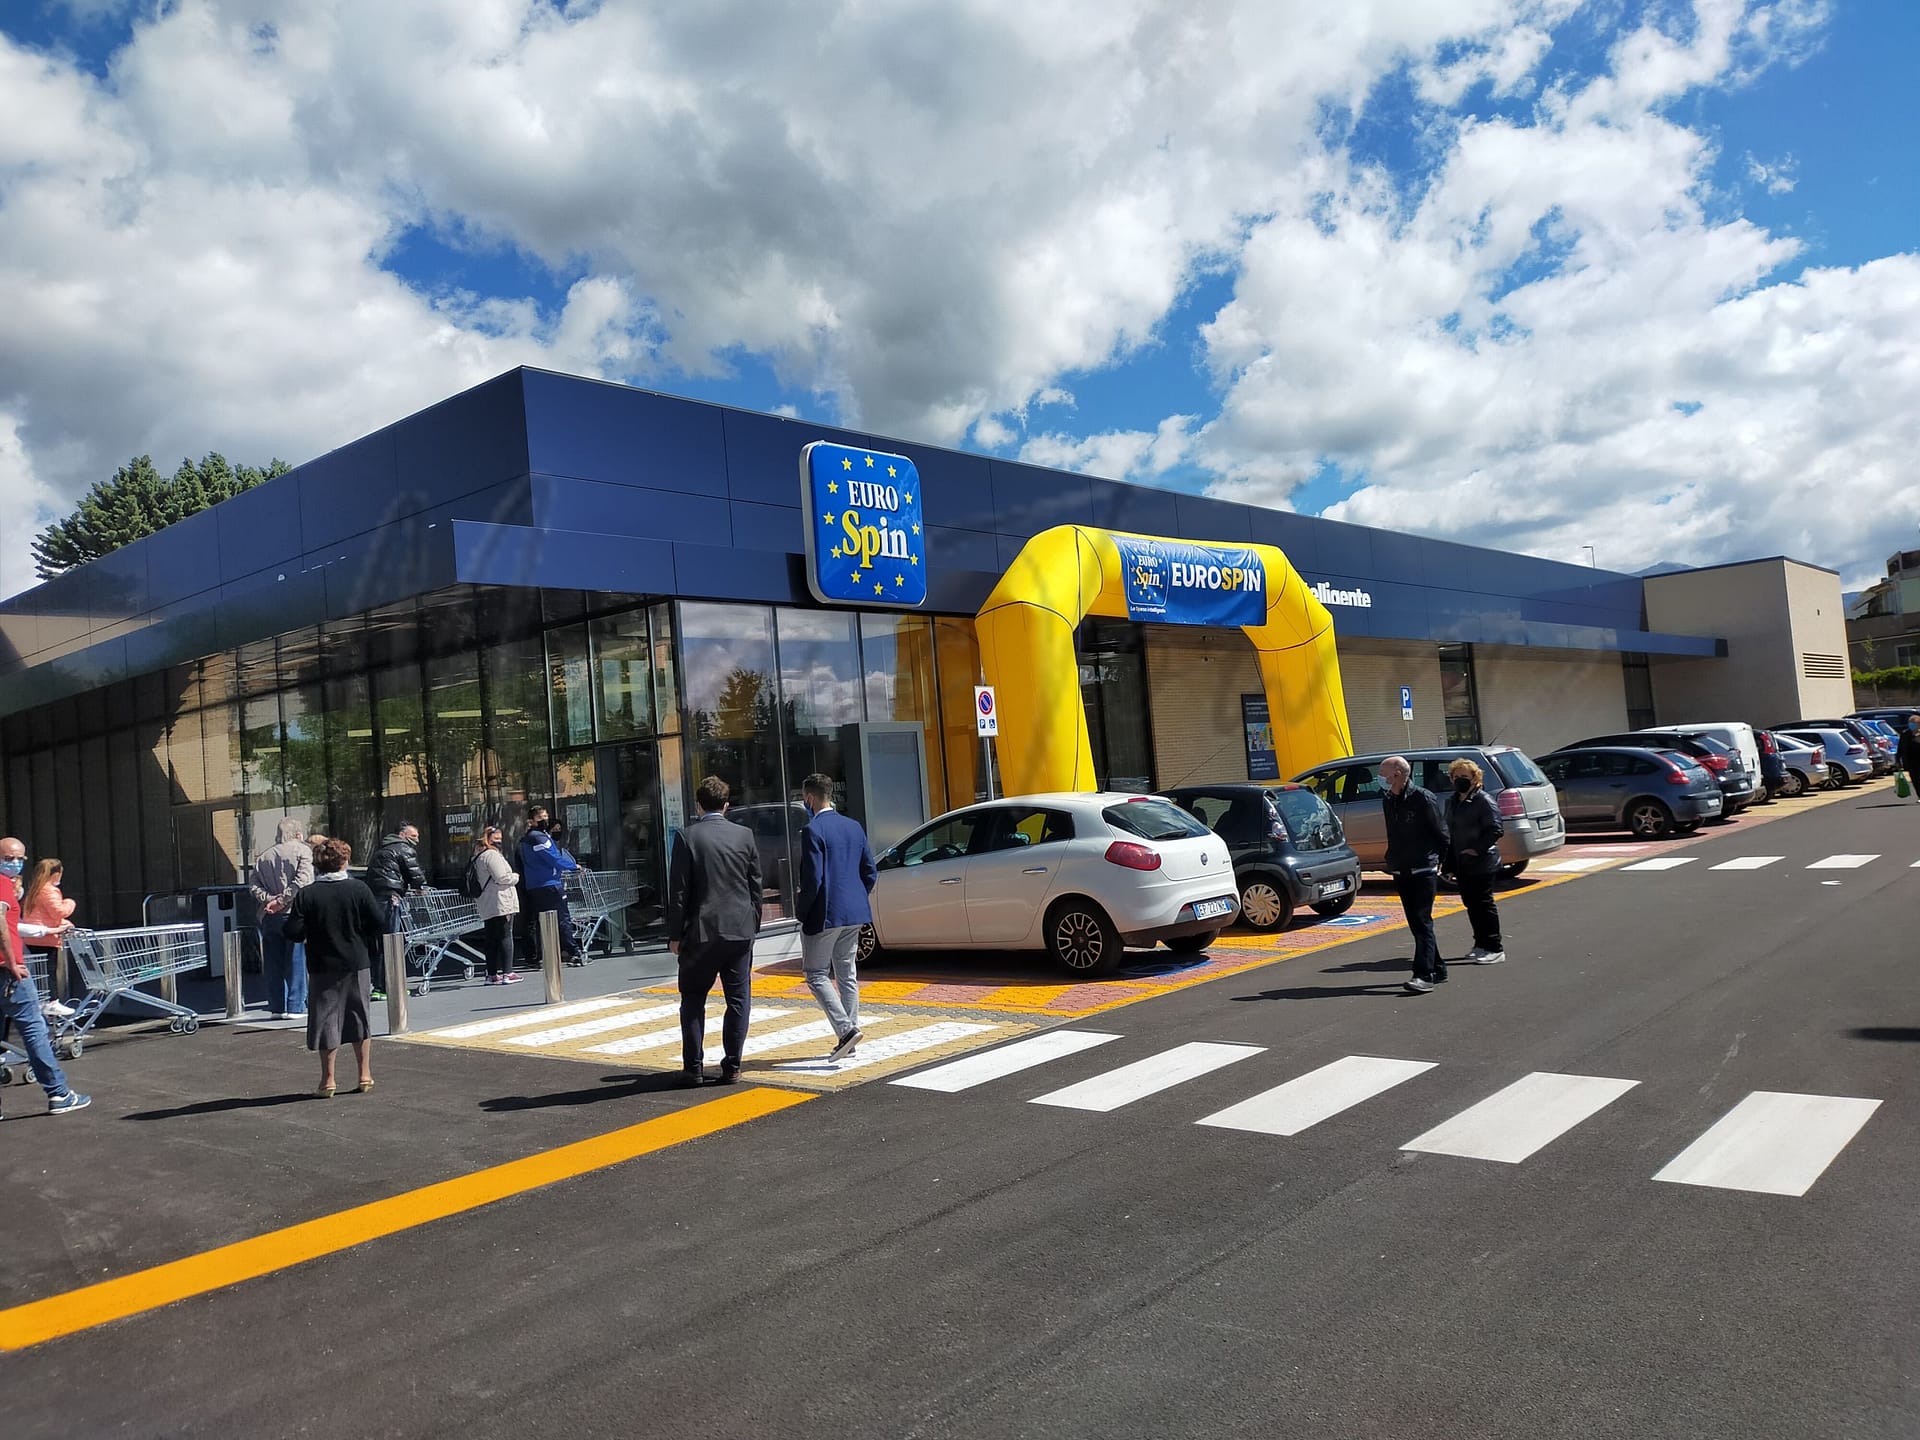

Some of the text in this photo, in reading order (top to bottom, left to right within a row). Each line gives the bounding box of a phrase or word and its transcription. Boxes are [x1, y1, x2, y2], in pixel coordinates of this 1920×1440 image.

[847, 480, 899, 512] EURO
[841, 509, 910, 569] Spin
[1138, 555, 1158, 568] EURO
[1135, 565, 1160, 590] Spin
[1171, 562, 1261, 592] EUROSPIN
[1402, 688, 1409, 706] P
